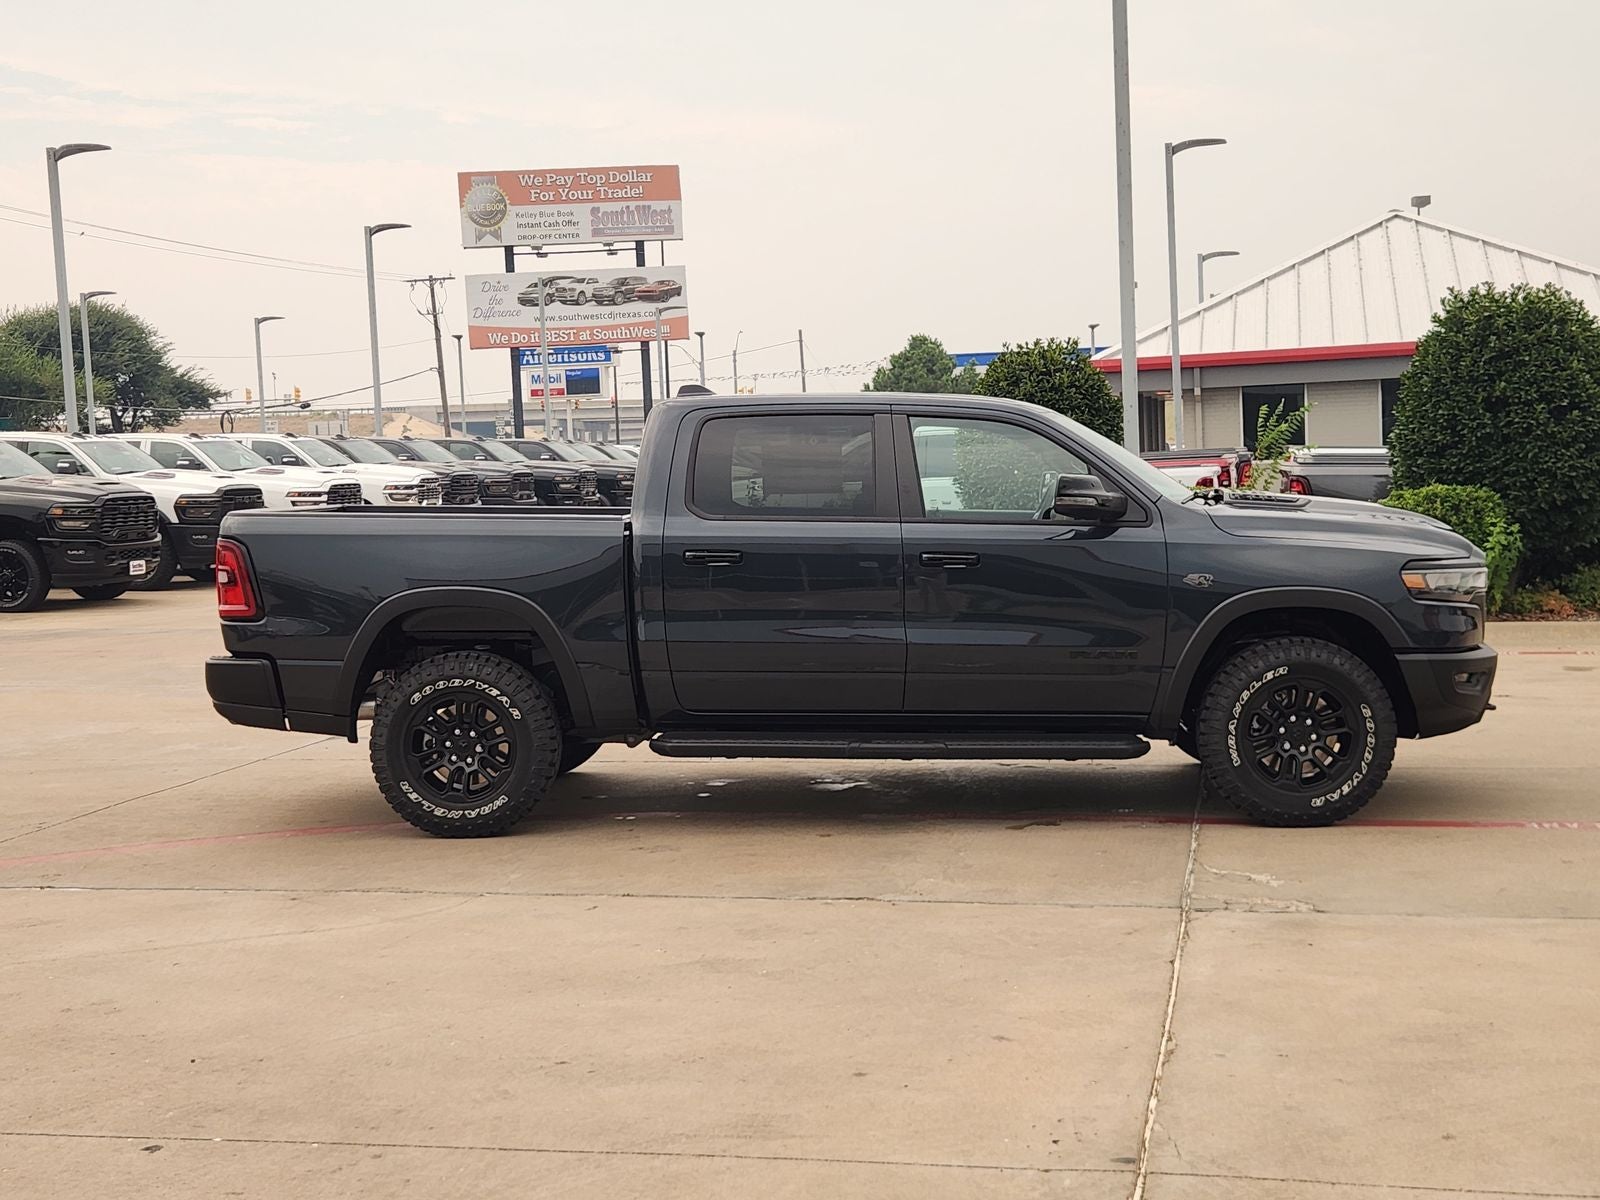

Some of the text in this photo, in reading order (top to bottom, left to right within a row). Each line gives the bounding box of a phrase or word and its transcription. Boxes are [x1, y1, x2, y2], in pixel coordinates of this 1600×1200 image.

[518, 169, 653, 188] We Pay Top Dollar
[530, 185, 643, 202] For Your Trade!
[486, 202, 506, 211] BOOK
[515, 209, 575, 220] Kelley Blue Book
[590, 204, 674, 227] SouthWest
[516, 219, 580, 229] Instant Cash Offer
[517, 232, 580, 241] DROP-OFF CENTER
[481, 280, 510, 292] Drive
[488, 294, 503, 305] the
[472, 306, 521, 321] Difference
[534, 310, 661, 322] ww.southwestcdjrtexas.co
[487, 325, 670, 345] We Do it BEST at SouthWes!!!
[523, 350, 605, 364] Alertsons
[409, 679, 522, 720] GOODYEAR
[1228, 666, 1288, 767] WRANGLER
[1311, 703, 1376, 807] GOODYEAR
[400, 780, 508, 818] WRANGLER
